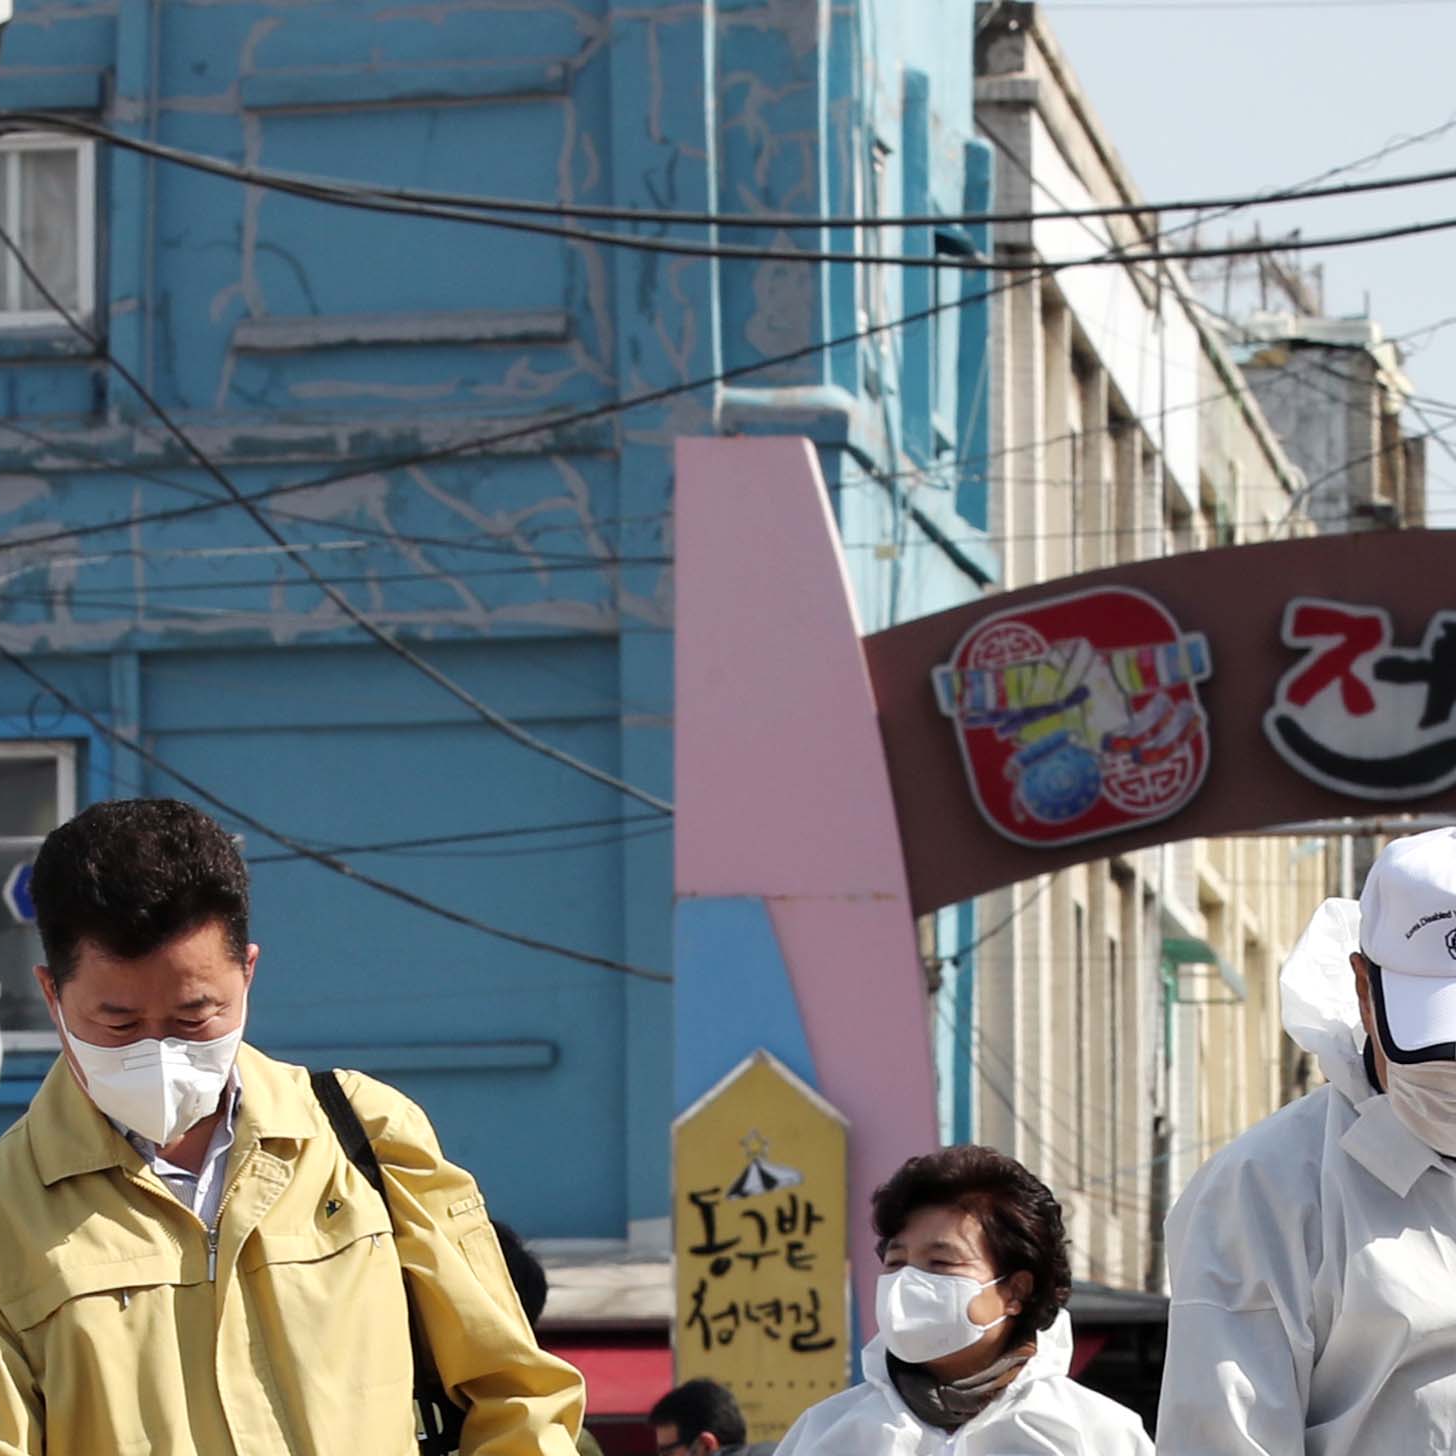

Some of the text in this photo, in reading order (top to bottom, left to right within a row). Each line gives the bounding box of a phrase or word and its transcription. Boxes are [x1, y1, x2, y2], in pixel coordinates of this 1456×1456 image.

[1420, 910, 1452, 926] Disabled
[688, 1187, 825, 1277] 동구밭
[686, 1278, 837, 1353] 청년길
